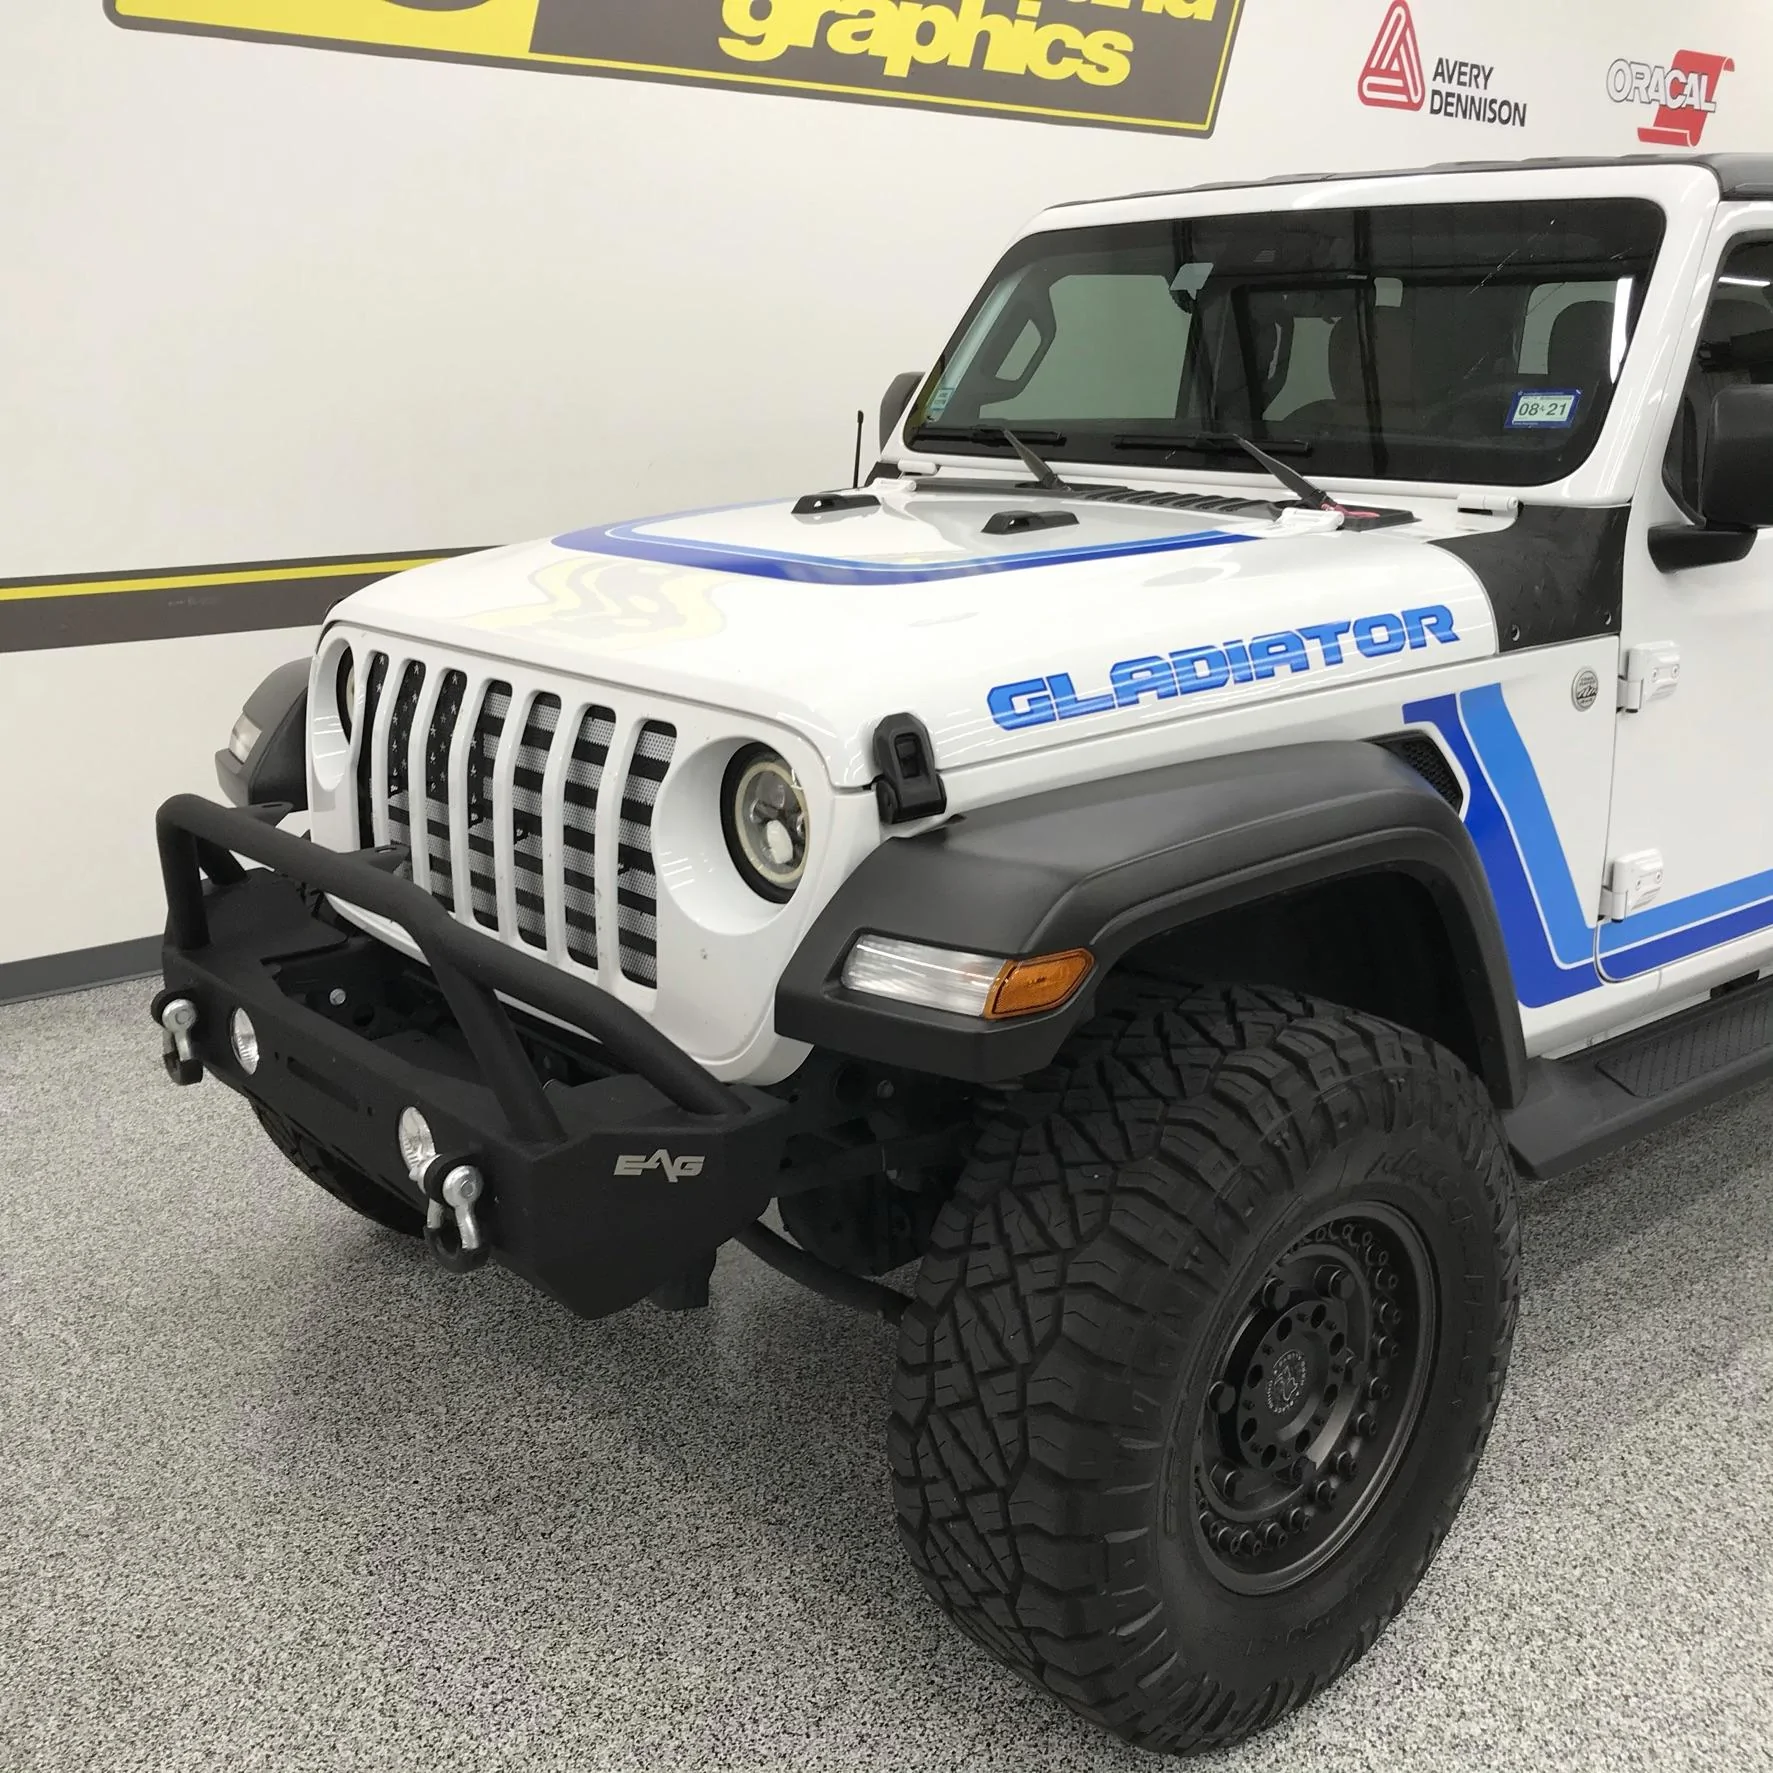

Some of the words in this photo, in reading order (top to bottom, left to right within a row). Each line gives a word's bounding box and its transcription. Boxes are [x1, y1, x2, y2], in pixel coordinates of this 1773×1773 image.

[718, 0, 1134, 86] graphics
[1433, 57, 1494, 90] AVERY
[1606, 58, 1716, 112] ORACAL
[1429, 89, 1527, 127] DENNISON
[986, 604, 1460, 731] GLADIATOR
[613, 1149, 706, 1182] EAG
